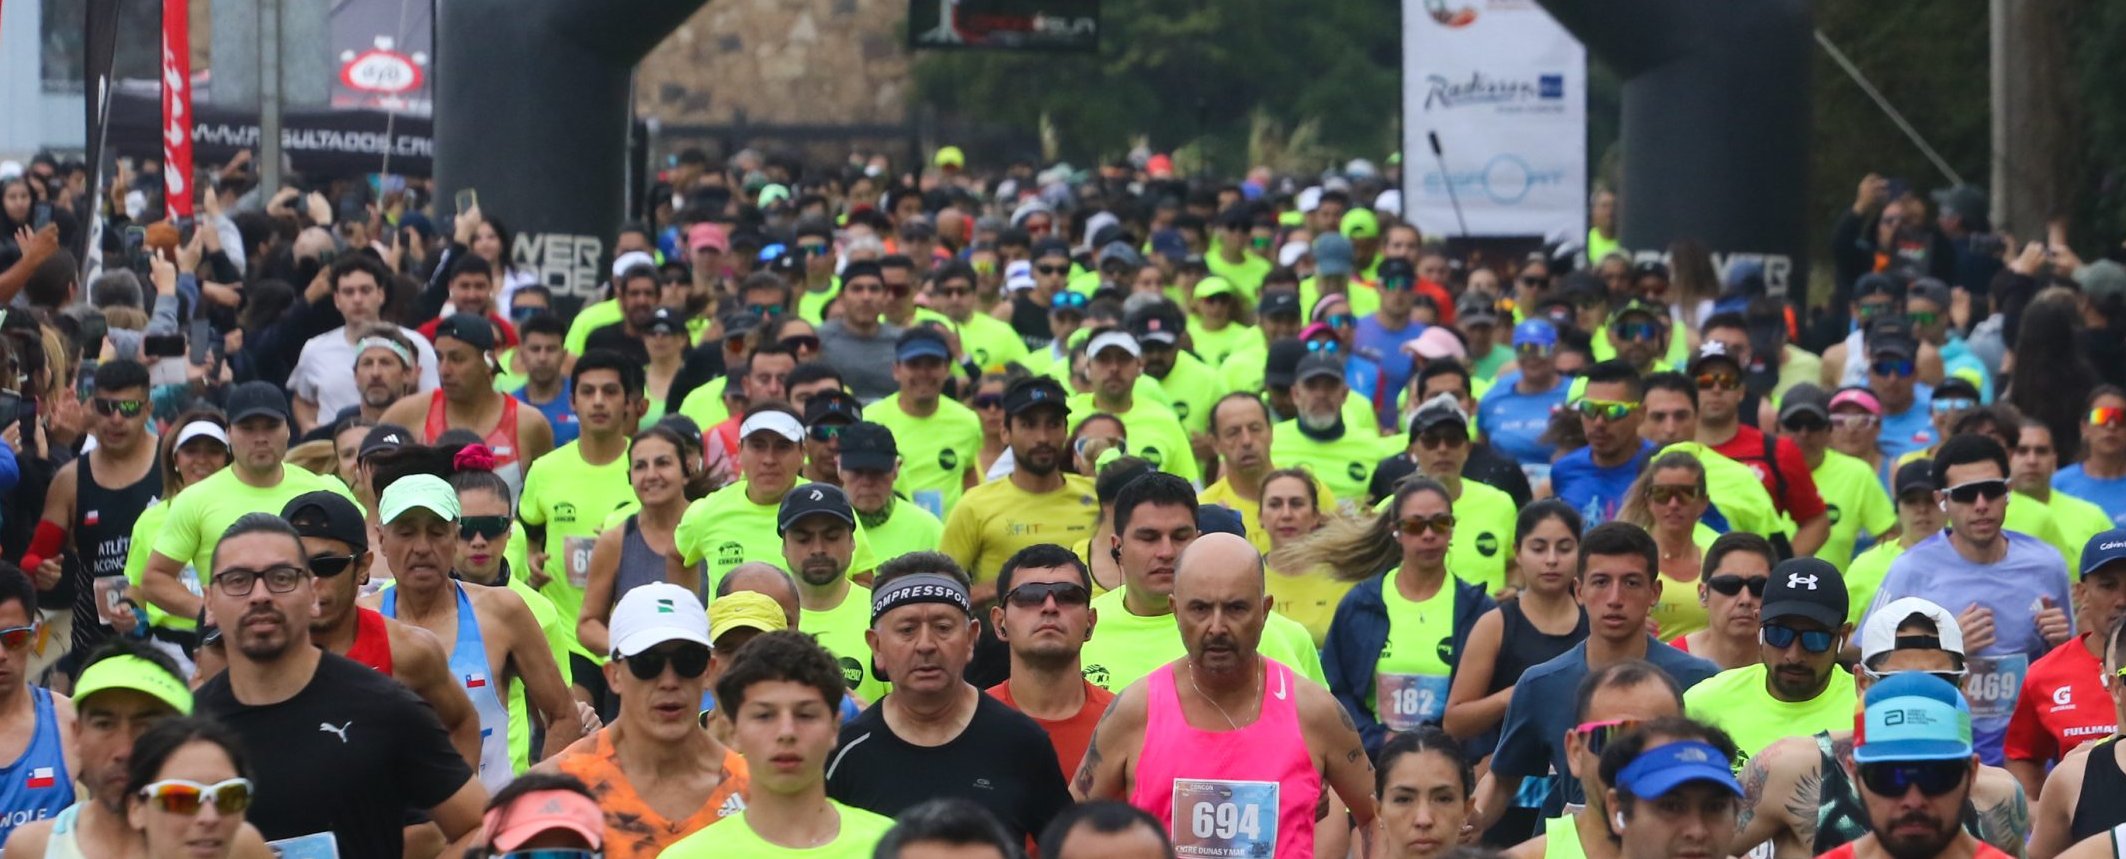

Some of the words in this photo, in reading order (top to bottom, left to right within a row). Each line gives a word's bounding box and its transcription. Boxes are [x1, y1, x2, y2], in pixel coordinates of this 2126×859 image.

[872, 585, 971, 617] COMPRESSPORT
[1968, 671, 2017, 701] 469
[2053, 685, 2071, 705] G
[1391, 688, 1435, 715] 182
[1192, 801, 1260, 840] 694
[1198, 847, 1223, 856] DUNAS
